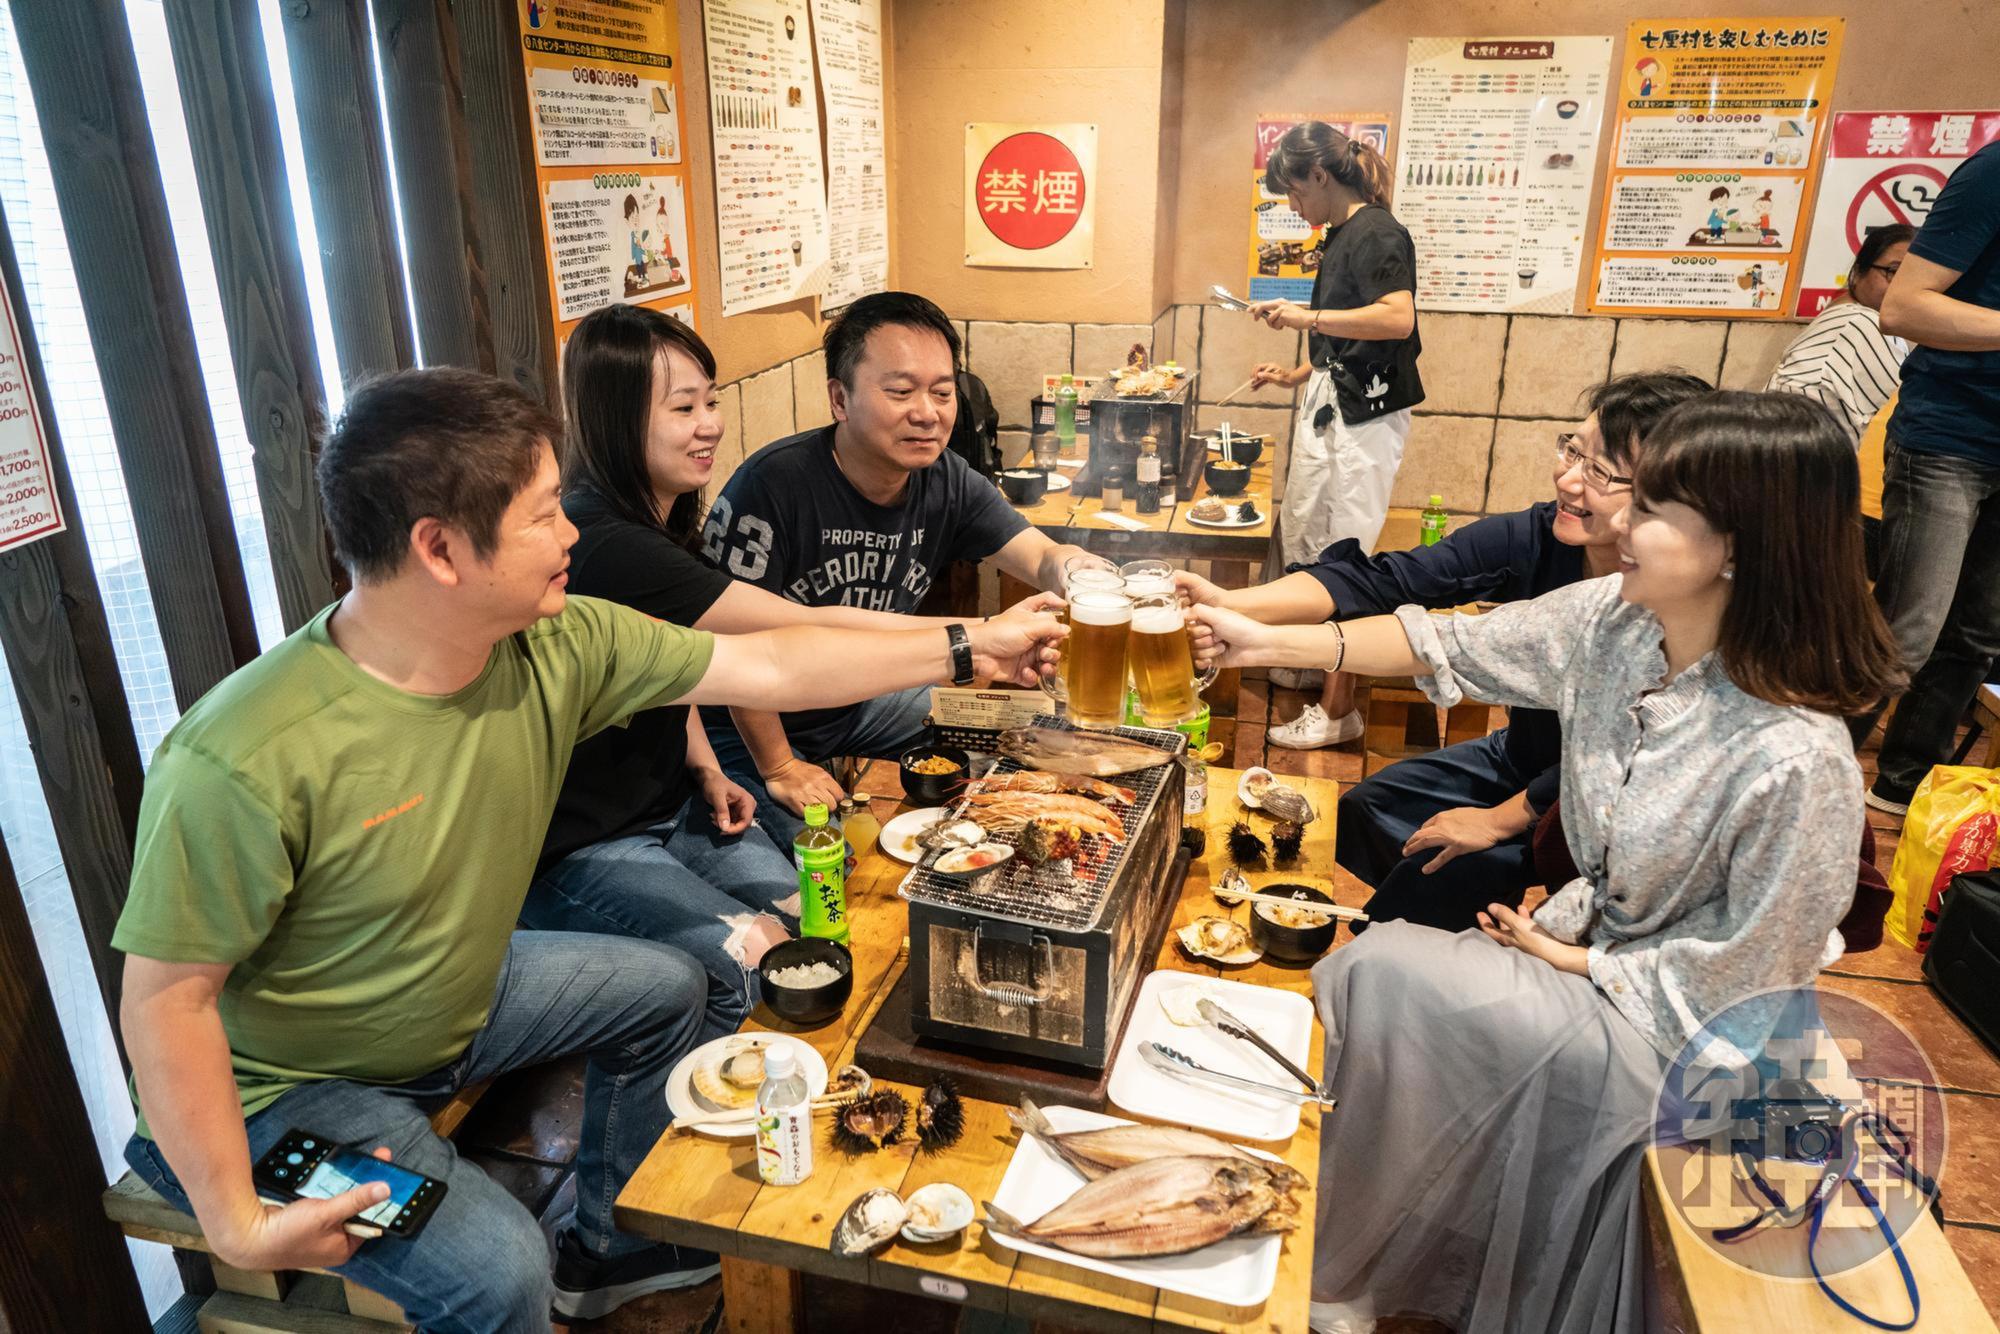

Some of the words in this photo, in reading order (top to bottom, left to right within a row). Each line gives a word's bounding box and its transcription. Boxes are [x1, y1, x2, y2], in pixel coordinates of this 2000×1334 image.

[1639, 28, 1830, 50] 七厘村を楽しむために
[1866, 114, 1976, 155] 禁煙
[983, 168, 1079, 215] 禁煙
[1, 458, 41, 477] 1,700円
[6, 486, 46, 505] 2,000円
[13, 511, 52, 532] 2,500円
[702, 496, 774, 581] 23
[822, 529, 902, 550] PROPERTY
[818, 883, 844, 924] お茶
[789, 1115, 801, 1180] 青森のおもてなし
